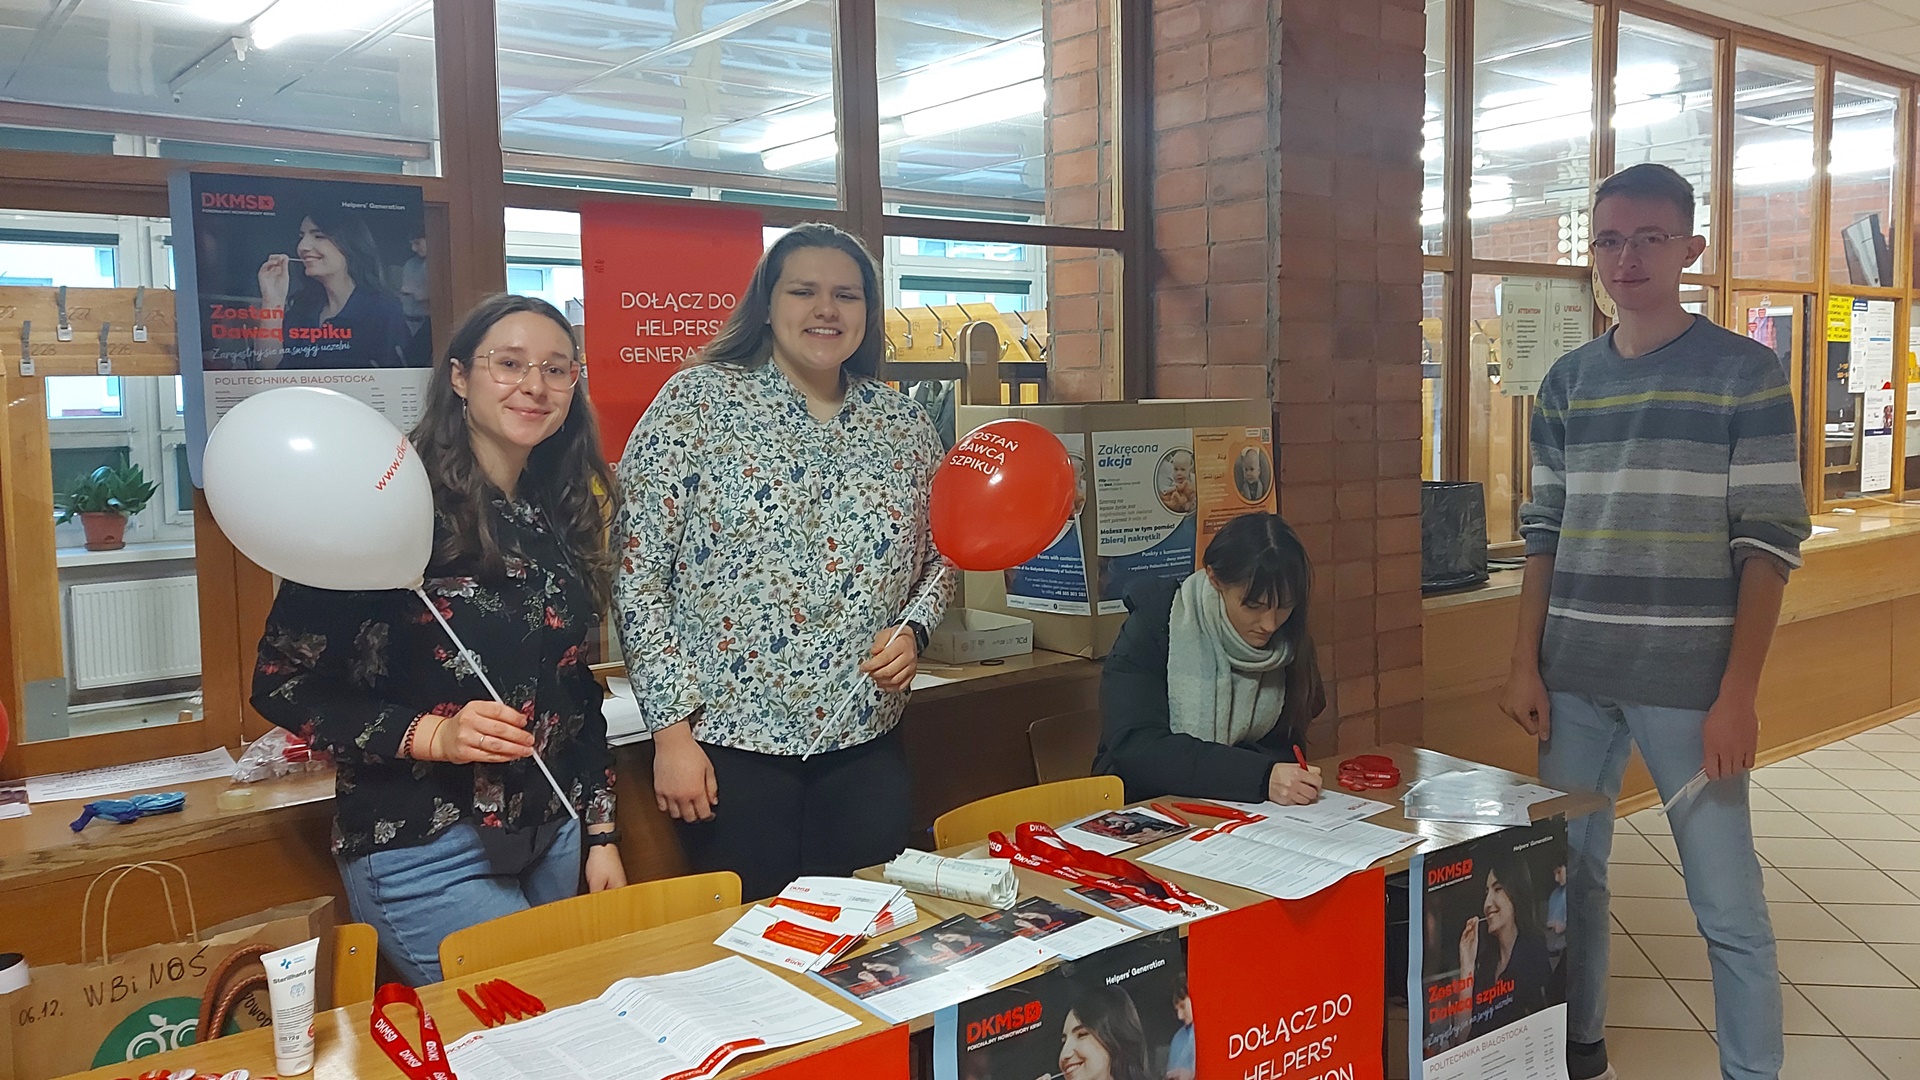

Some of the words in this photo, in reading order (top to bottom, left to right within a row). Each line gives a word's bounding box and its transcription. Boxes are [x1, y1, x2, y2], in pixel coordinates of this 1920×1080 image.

[201, 192, 259, 209] DKMS
[210, 304, 284, 319] Zostań
[621, 292, 704, 312] DOŁĄCZ
[708, 293, 737, 310] DO
[211, 324, 284, 342] Dawcą
[289, 323, 352, 343] szpiku
[636, 320, 724, 337] HELPERS'
[214, 376, 297, 385] POLITECHNIKA
[300, 374, 375, 384] BIAŁOSTOCKA
[969, 431, 1018, 452] OSTAŃ
[1098, 444, 1158, 456] Zakręcona
[1098, 455, 1132, 469] akcja
[1101, 535, 1126, 545] Zbieraj
[1128, 533, 1160, 543] nakrętki!
[1428, 861, 1463, 886] DKMS
[1105, 968, 1131, 985] Helpers'
[1131, 959, 1166, 976] Generation
[1428, 972, 1474, 1003] Zostań
[1476, 979, 1515, 1005] szpiku
[19, 999, 64, 1026] 06.12.
[966, 1005, 1025, 1044] DKMS
[1228, 1004, 1318, 1060] DOŁĄCZ
[1322, 993, 1352, 1024] DO
[1429, 1044, 1480, 1073] POLITECHNIKA
[1481, 1024, 1529, 1052] BIAŁOSTOCKA
